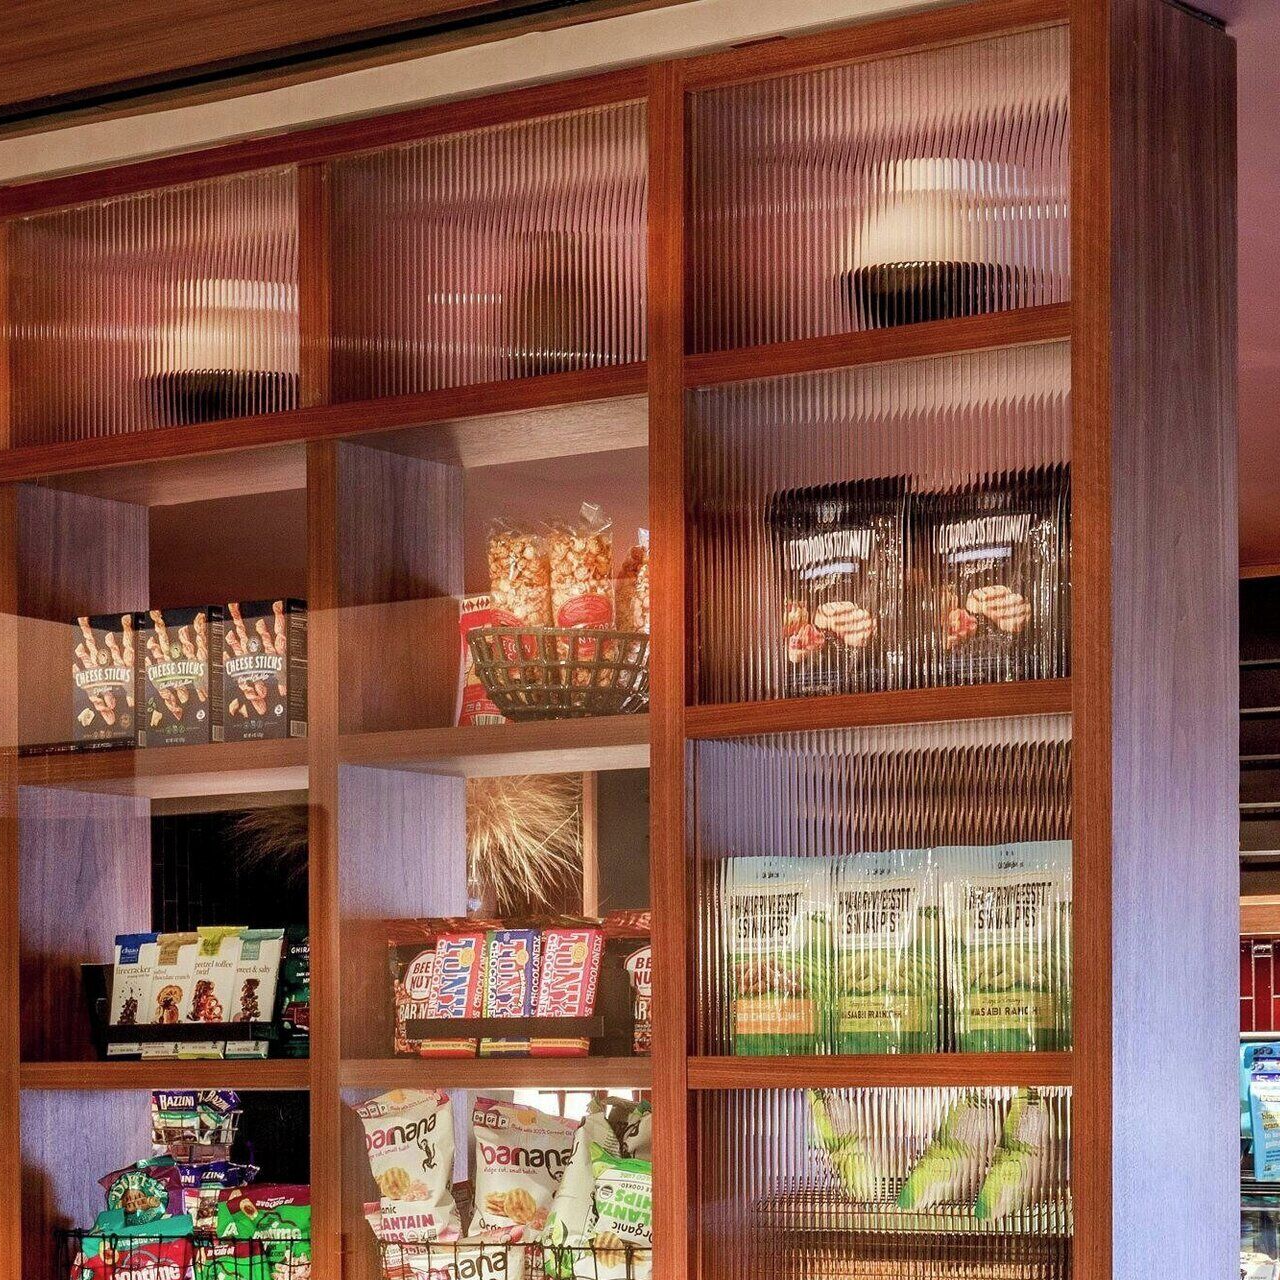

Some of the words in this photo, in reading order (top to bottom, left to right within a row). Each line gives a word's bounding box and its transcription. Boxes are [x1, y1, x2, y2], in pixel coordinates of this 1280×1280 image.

[147, 663, 177, 681] CHEESE
[225, 657, 254, 675] CHEESE
[76, 670, 103, 687] CHEESE
[195, 960, 214, 969] pretzel
[215, 960, 233, 968] toffee
[413, 961, 432, 974] BEE
[531, 936, 541, 1006] CHOCOLONELY
[586, 934, 603, 1004] CHOCOLONELY
[410, 975, 432, 989] NUT
[426, 939, 447, 1018] CHOCOLONE
[488, 940, 499, 1018] CHOCOLONE
[538, 933, 558, 1017] CHOCOLONE
[159, 1094, 195, 1110] BAZZINI
[615, 1189, 652, 1209] HIPS
[381, 1204, 397, 1214] anic
